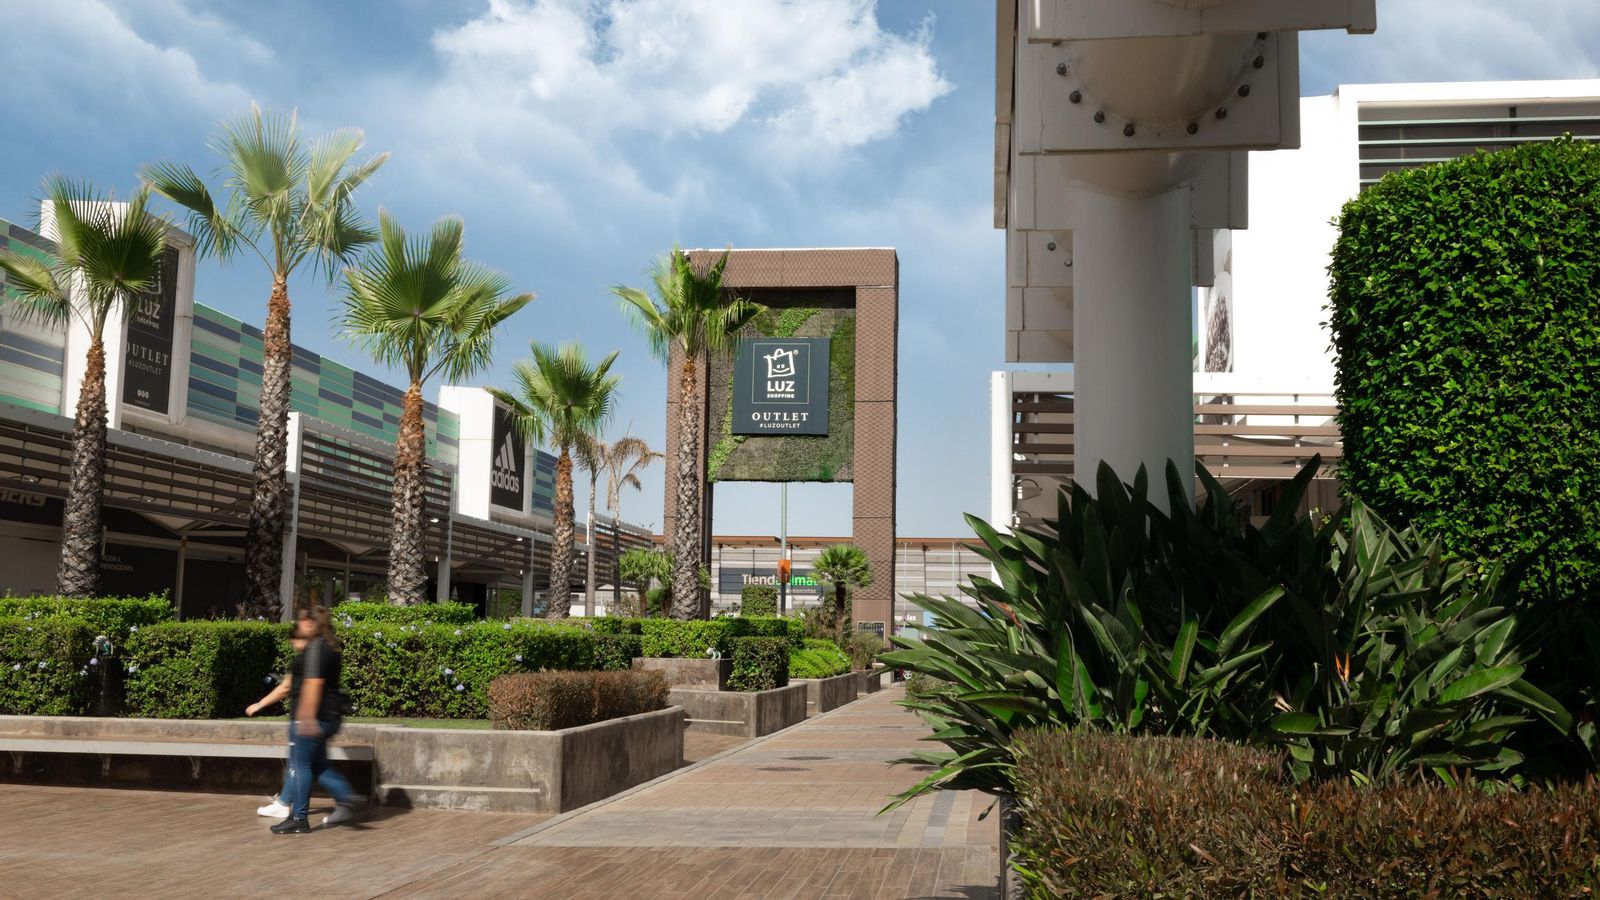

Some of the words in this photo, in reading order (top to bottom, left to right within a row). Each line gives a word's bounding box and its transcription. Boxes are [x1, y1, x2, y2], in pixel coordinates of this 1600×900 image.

[767, 381, 795, 392] LUZ
[752, 412, 809, 421] OUTLET
[492, 468, 519, 493] adidas
